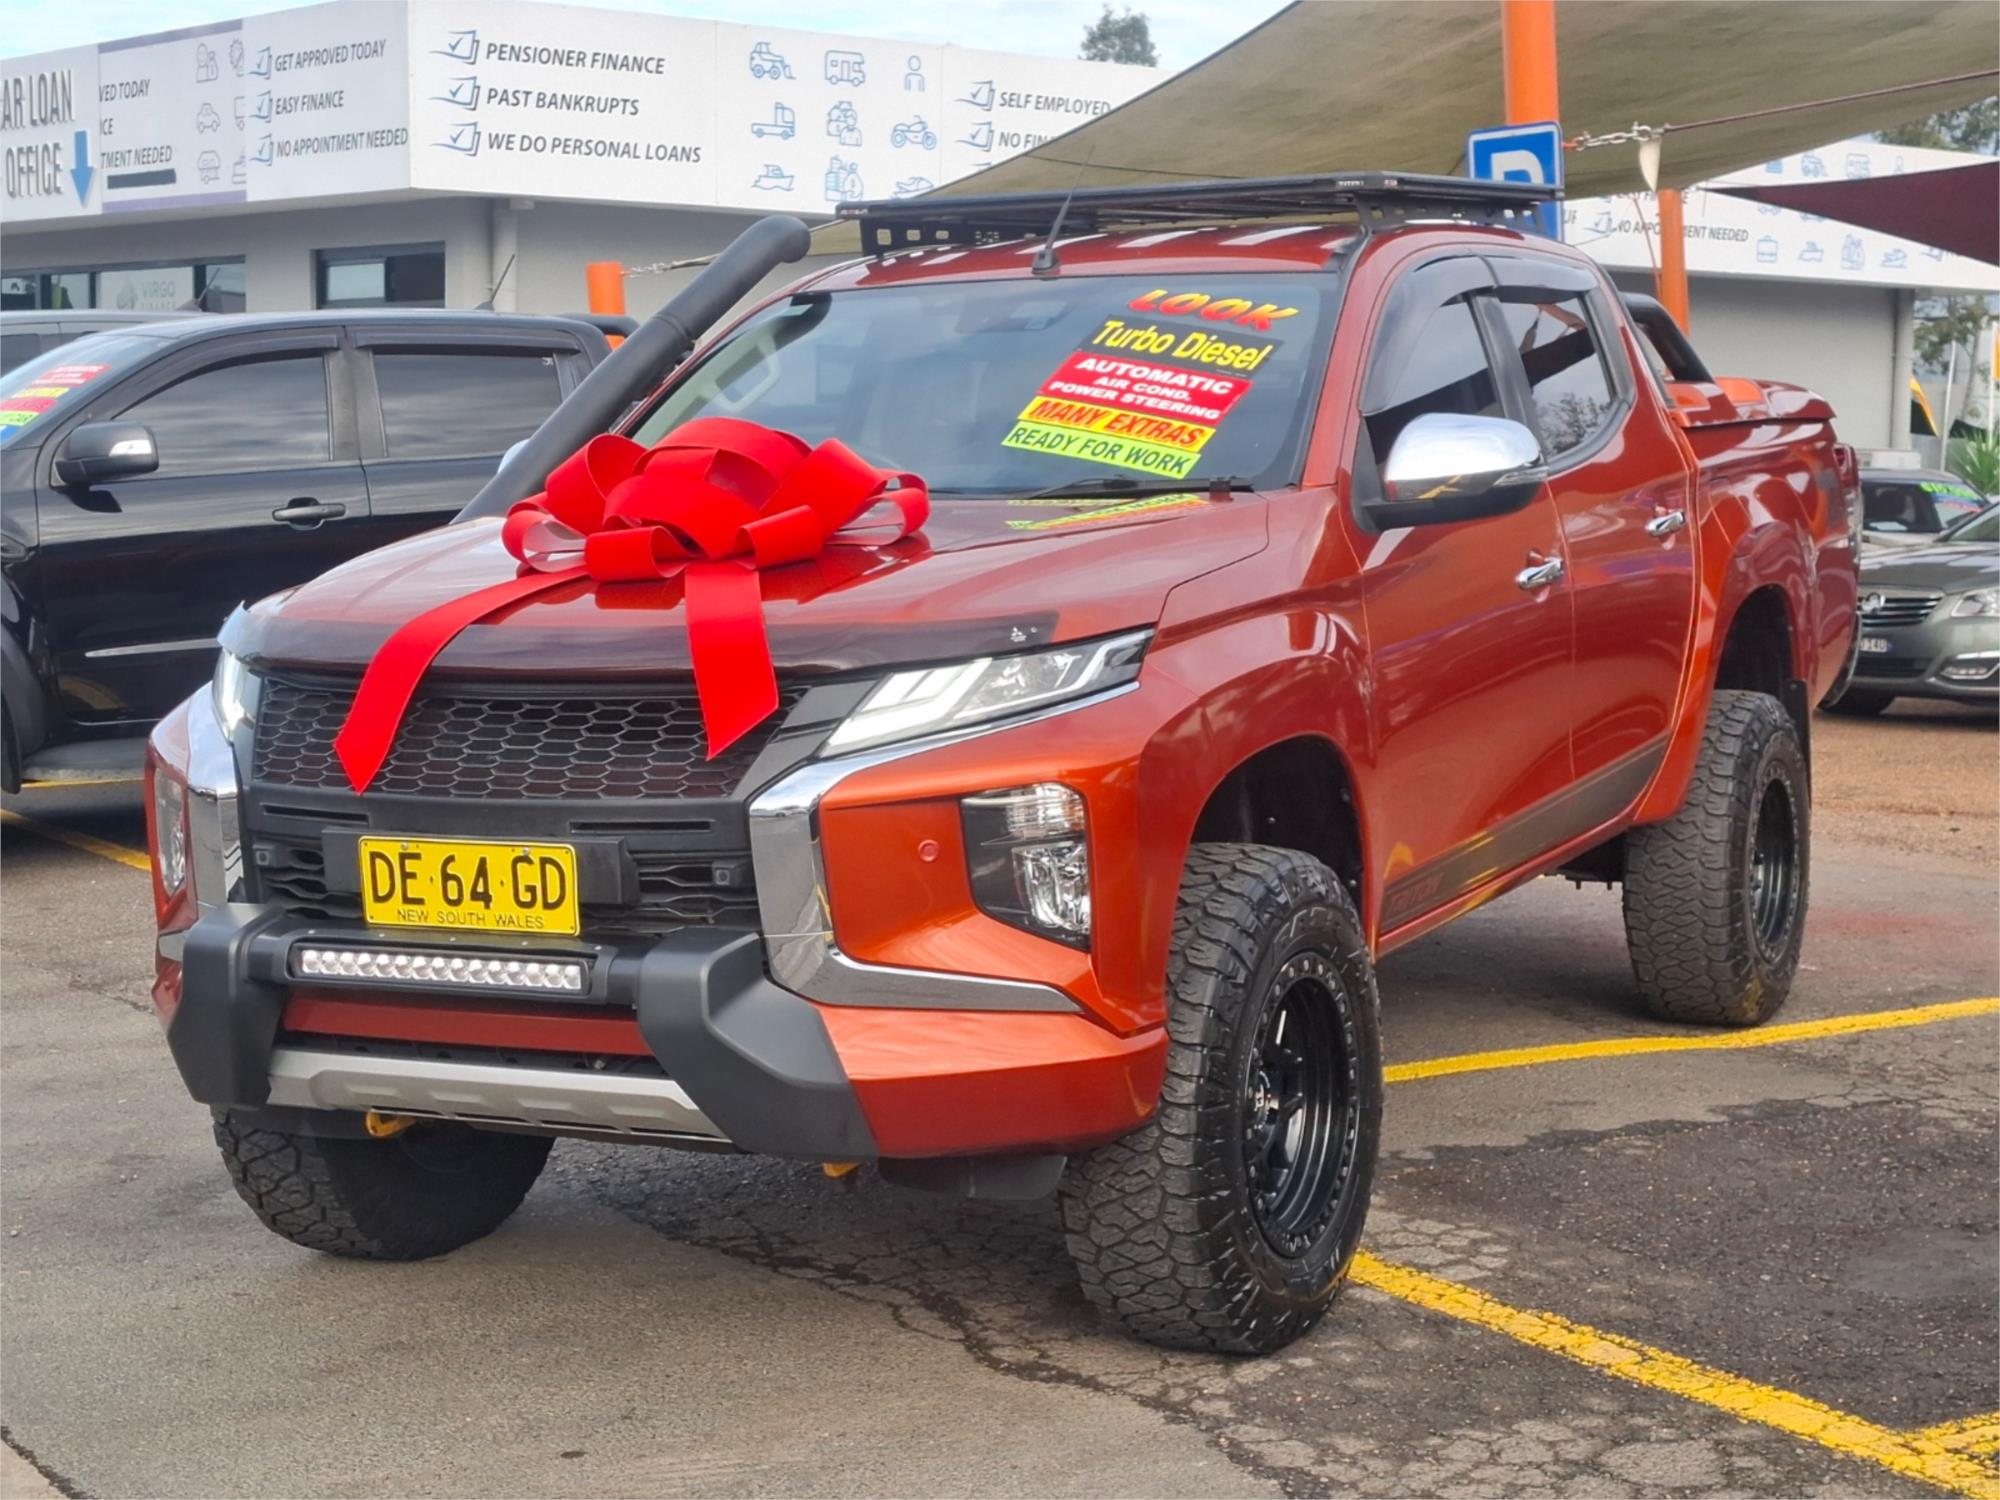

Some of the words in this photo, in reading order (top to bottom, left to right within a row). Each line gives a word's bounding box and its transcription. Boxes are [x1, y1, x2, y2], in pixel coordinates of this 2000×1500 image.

[275, 52, 294, 72] GET
[295, 45, 349, 69] APPROVED
[350, 39, 386, 61] TODAY
[486, 42, 588, 68] PENSIONER
[590, 52, 665, 75] FINANCE
[29, 69, 74, 127] LOAN
[118, 78, 151, 99] TODAY
[275, 95, 301, 115] EASY
[301, 90, 344, 112] FINANCE
[486, 87, 532, 108] PAST
[535, 91, 640, 116] BANKRUPTS
[999, 91, 1032, 109] SELF
[1034, 95, 1112, 116] EMPLOYED
[276, 139, 291, 157] NO
[292, 132, 365, 156] APPOINTMENT
[366, 127, 409, 149] NEEDED
[488, 132, 516, 151] WE
[519, 135, 547, 154] DO
[551, 137, 641, 160] PERSONAL
[645, 143, 702, 163] LOANS
[998, 131, 1021, 148] NO
[6, 142, 63, 198] OFFICE
[134, 145, 173, 166] NEEDED
[1708, 227, 1749, 242] NEEDED
[1128, 289, 1299, 331] LOOK
[1092, 319, 1175, 354] Turbo
[1171, 331, 1274, 371] Diesel
[1075, 357, 1233, 395] AUTOMATIC
[1094, 376, 1130, 391] AIR
[1132, 381, 1192, 402] COND.
[1049, 381, 1121, 402] POWER
[1121, 391, 1221, 420] STEERING
[1029, 399, 1111, 427] MANY
[1104, 412, 1207, 447] EXTRAS
[1007, 426, 1079, 450] READY
[1078, 438, 1124, 463] FOR
[1125, 450, 1191, 475] WORK
[397, 909, 430, 923] NEW
[436, 911, 486, 926] SOUTH
[495, 914, 544, 929] WALES
